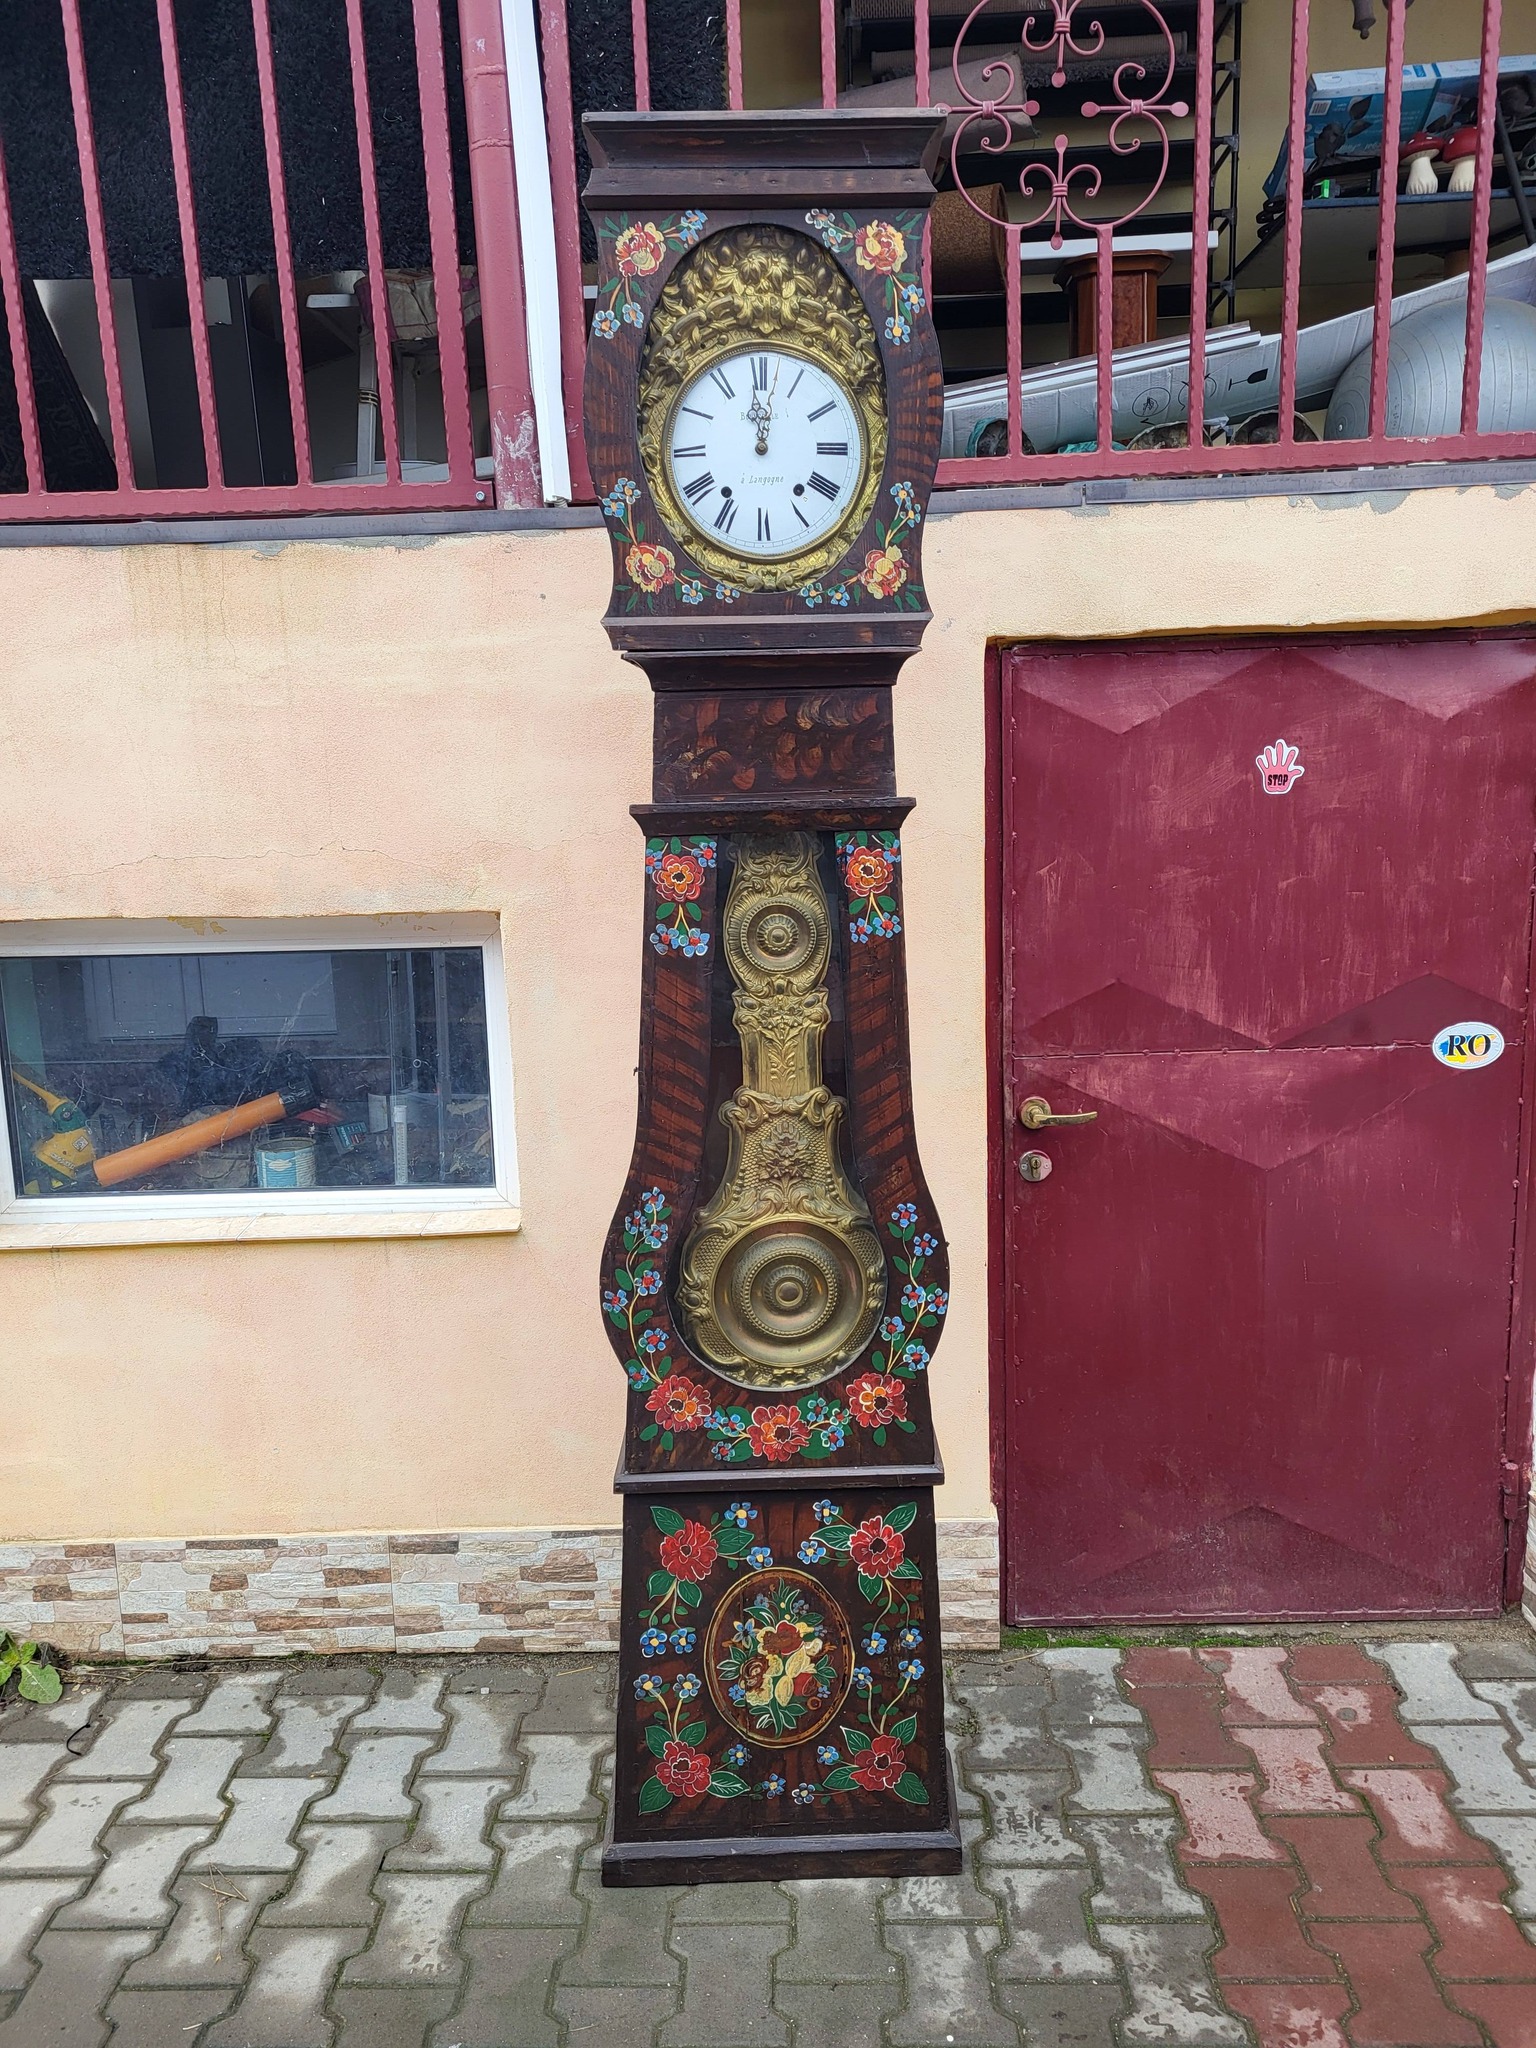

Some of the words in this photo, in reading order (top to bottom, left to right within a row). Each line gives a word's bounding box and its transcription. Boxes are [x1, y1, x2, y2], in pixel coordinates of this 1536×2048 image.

[806, 400, 838, 423] II
[816, 442, 848, 456] III
[1267, 773, 1289, 786] STOP
[1447, 1033, 1491, 1057] RO
